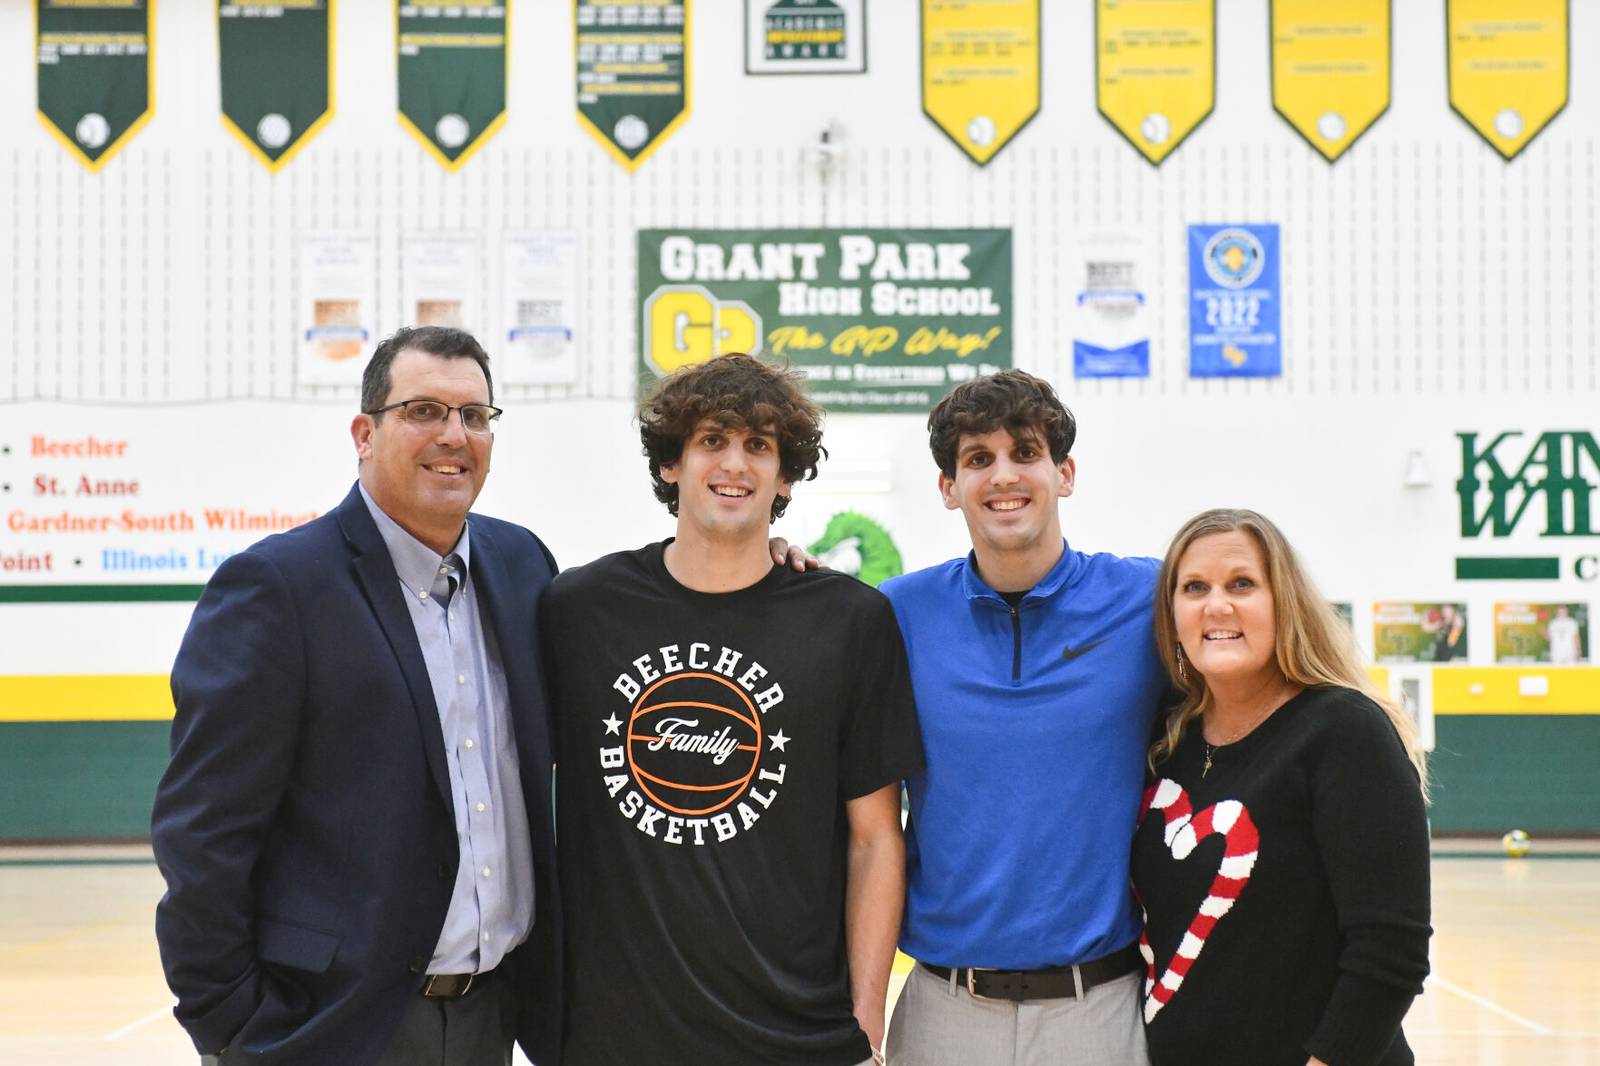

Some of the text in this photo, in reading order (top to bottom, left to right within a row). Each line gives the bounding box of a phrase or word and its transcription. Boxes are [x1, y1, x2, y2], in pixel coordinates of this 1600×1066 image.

[659, 235, 972, 281] GRANT PARK
[778, 282, 1001, 316] HIGH SCHOOL
[1206, 296, 1260, 326] 2022
[767, 325, 1002, 358] The GP Way!
[31, 436, 128, 457] Beecher
[34, 474, 139, 496] St. Anne
[7, 511, 194, 532] Gardner-South
[0, 551, 53, 571] oint
[103, 548, 187, 571] Illinois
[613, 642, 785, 714] BEECHER
[647, 717, 740, 765] Family
[600, 744, 787, 845] BASKETBALL
